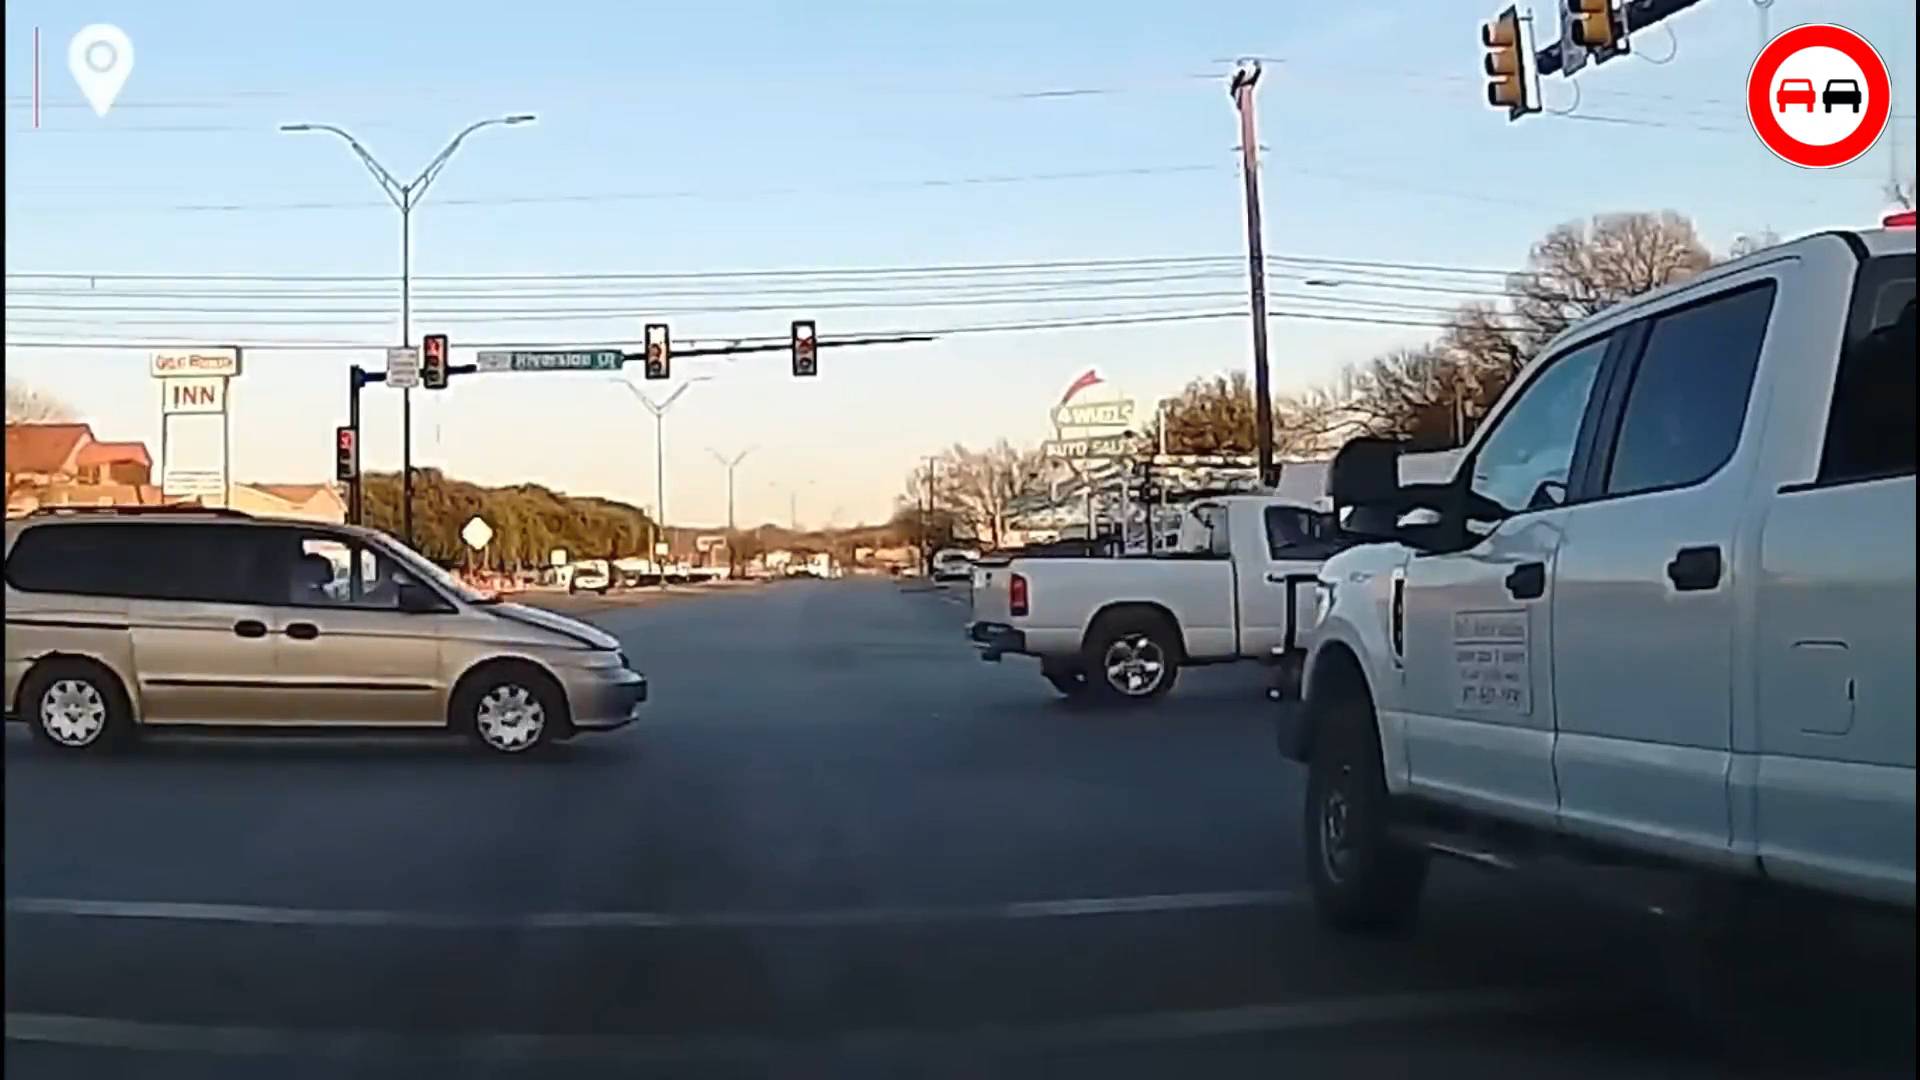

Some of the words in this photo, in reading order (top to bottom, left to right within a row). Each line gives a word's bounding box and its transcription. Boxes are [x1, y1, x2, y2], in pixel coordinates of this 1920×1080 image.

[514, 353, 592, 368] Riverside
[174, 386, 215, 407] INN
[1047, 442, 1087, 457] AUTO
[1092, 440, 1136, 456] SALES
